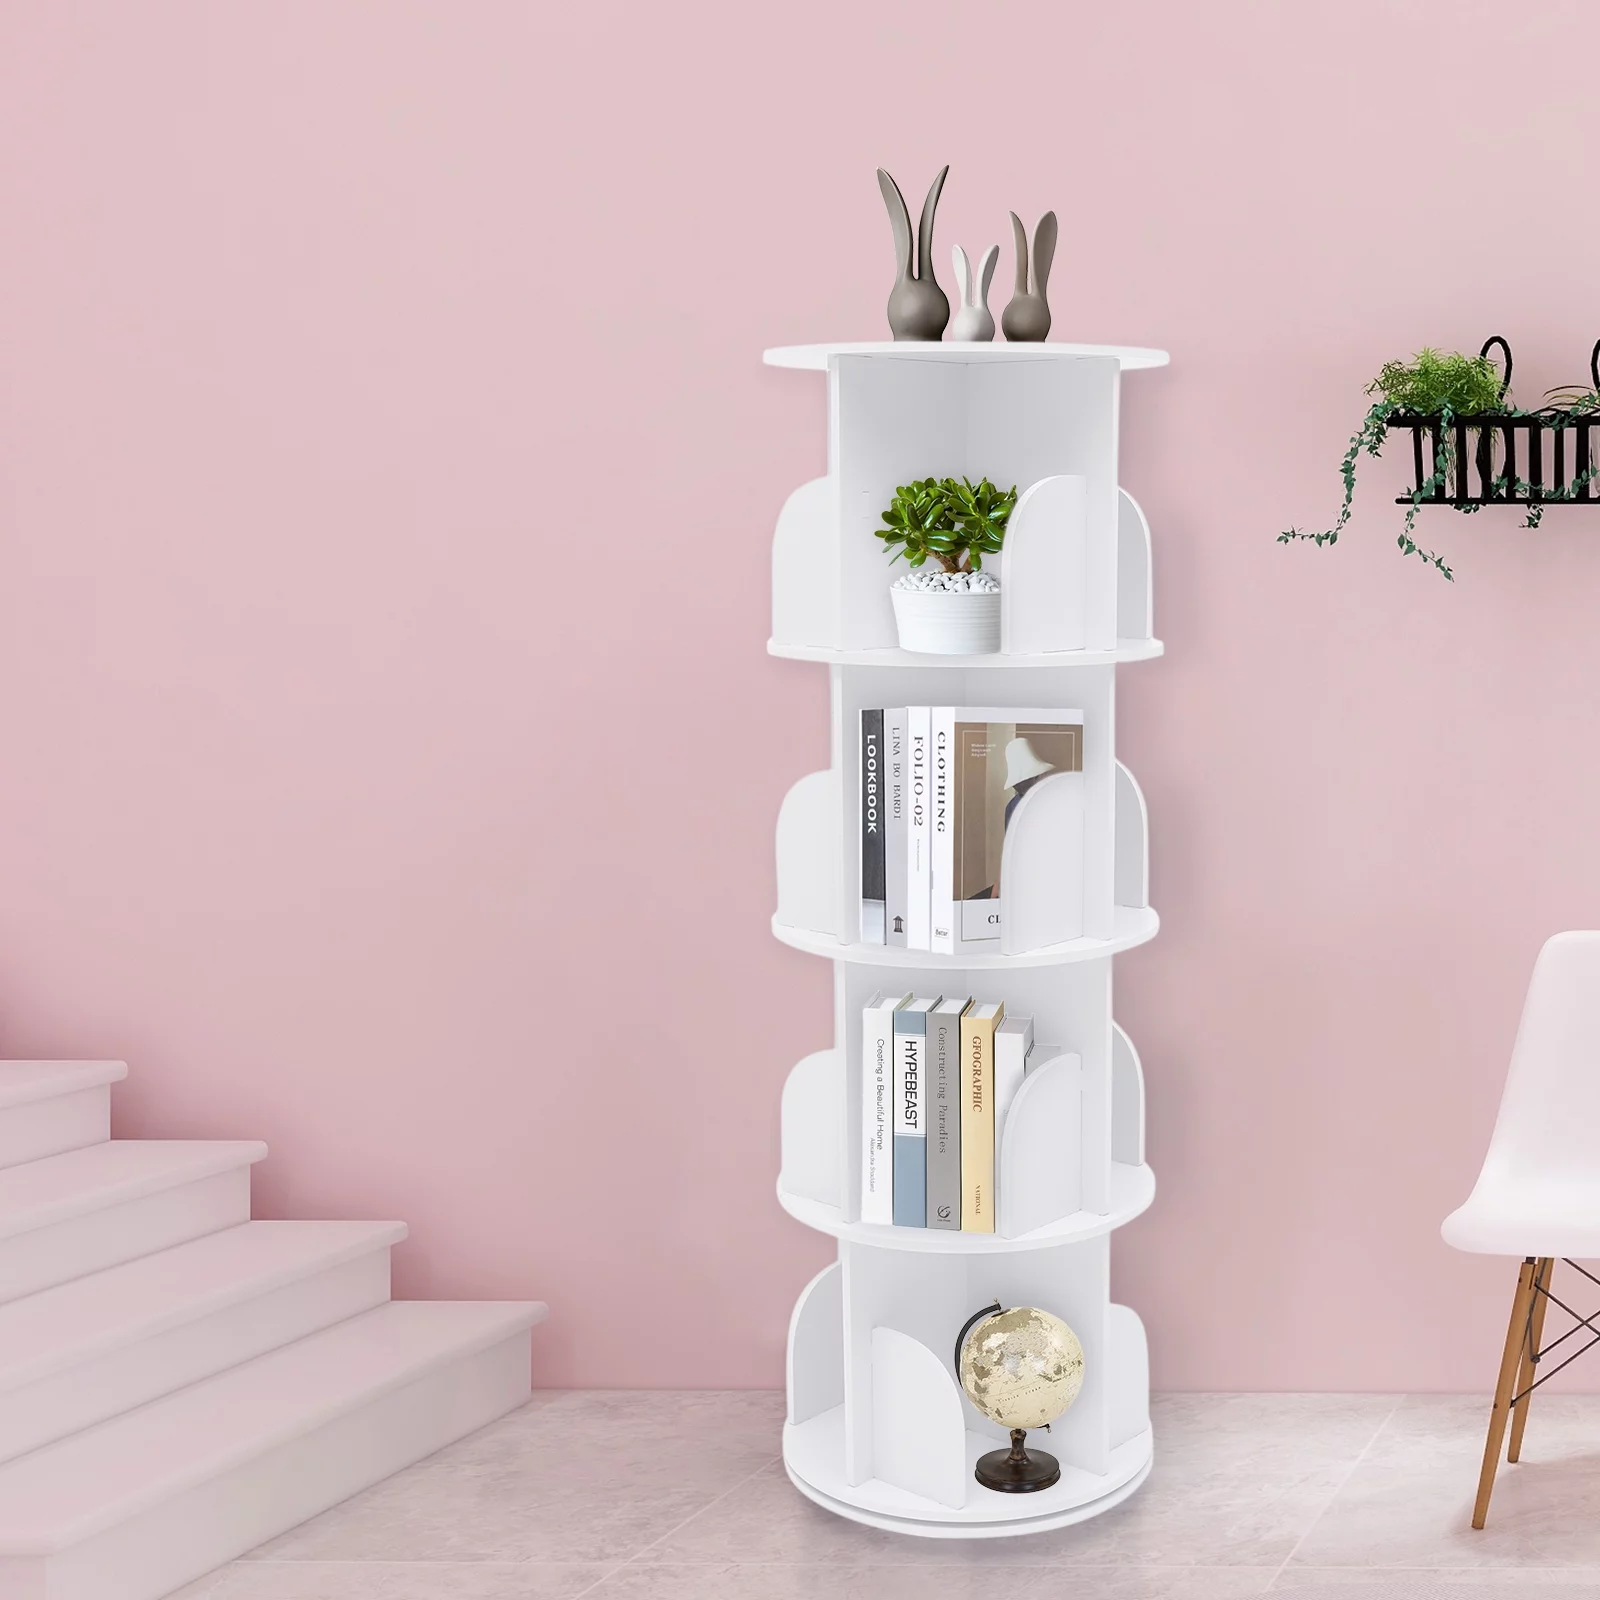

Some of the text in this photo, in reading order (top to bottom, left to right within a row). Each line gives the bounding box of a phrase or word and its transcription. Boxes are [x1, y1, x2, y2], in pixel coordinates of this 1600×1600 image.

[867, 734, 877, 834] LOOKBOOK
[892, 727, 901, 820] LINA BO BARDI
[914, 736, 924, 826] FOLIO-02
[937, 731, 946, 833] CLOTHING
[875, 1038, 884, 1074] Creating
[905, 1040, 917, 1129] HYPEBEAST
[938, 1027, 949, 1153] Constructing Paradies
[876, 1084, 885, 1122] Beautiful
[876, 1124, 884, 1150] Home
